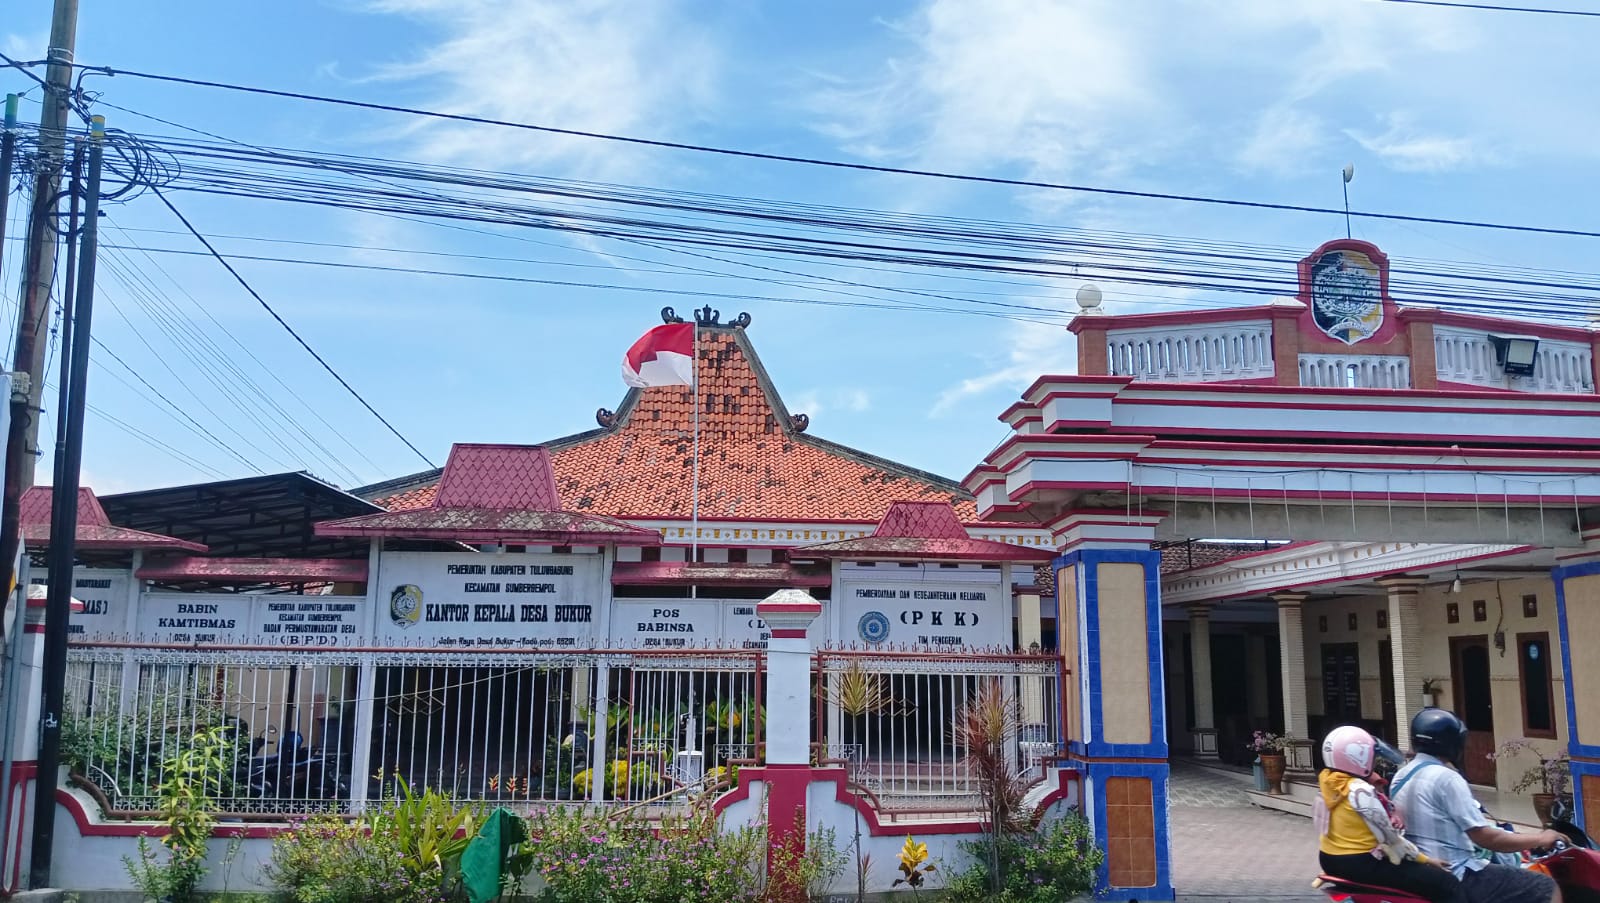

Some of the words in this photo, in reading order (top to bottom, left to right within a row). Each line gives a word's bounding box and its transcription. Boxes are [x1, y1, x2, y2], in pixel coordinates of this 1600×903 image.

[448, 564, 486, 574] PEMERINTAH
[490, 565, 526, 575] KABUPATEN
[464, 582, 500, 592] KECAMATAN
[900, 590, 910, 598] DAN
[178, 604, 218, 614] BABIN
[426, 604, 469, 622] KANTOR
[474, 604, 515, 622] KEPALA
[520, 604, 548, 622] DESA
[554, 605, 592, 623] BUKUR
[653, 608, 680, 618] POS
[158, 618, 236, 628] KAMTIBMAS
[637, 622, 694, 632] BABINSA
[264, 624, 281, 632] BADAN
[341, 624, 356, 634] DESA
[645, 638, 660, 646] DESA
[918, 636, 928, 644] TIM
